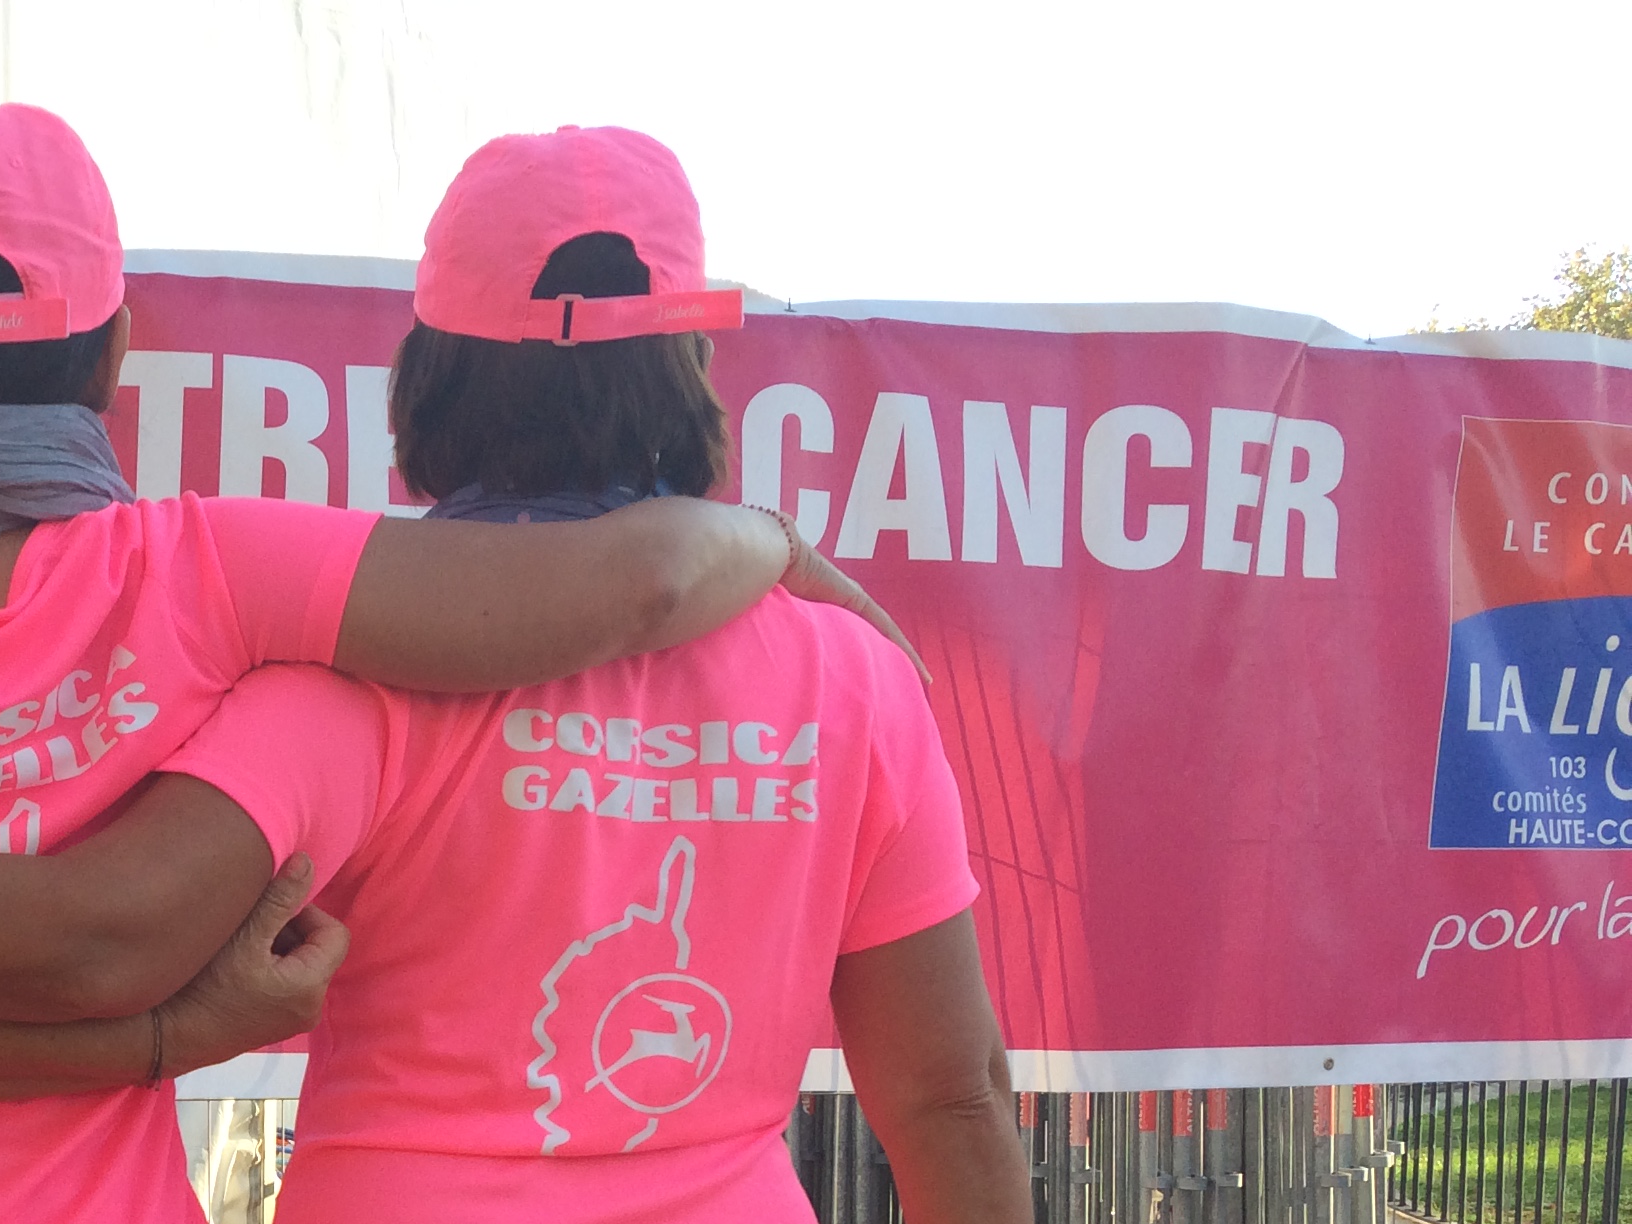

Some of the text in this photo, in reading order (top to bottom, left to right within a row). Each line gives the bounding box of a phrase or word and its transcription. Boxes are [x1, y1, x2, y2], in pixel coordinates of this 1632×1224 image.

[741, 382, 1345, 580] CANCER
[1503, 519, 1551, 553] LE
[1467, 662, 1531, 733] LA
[502, 708, 820, 768] CORSICA
[1549, 756, 1586, 779] 103
[502, 765, 817, 823] GAZELLES
[1492, 785, 1587, 814] comités
[1416, 901, 1587, 979] pour
